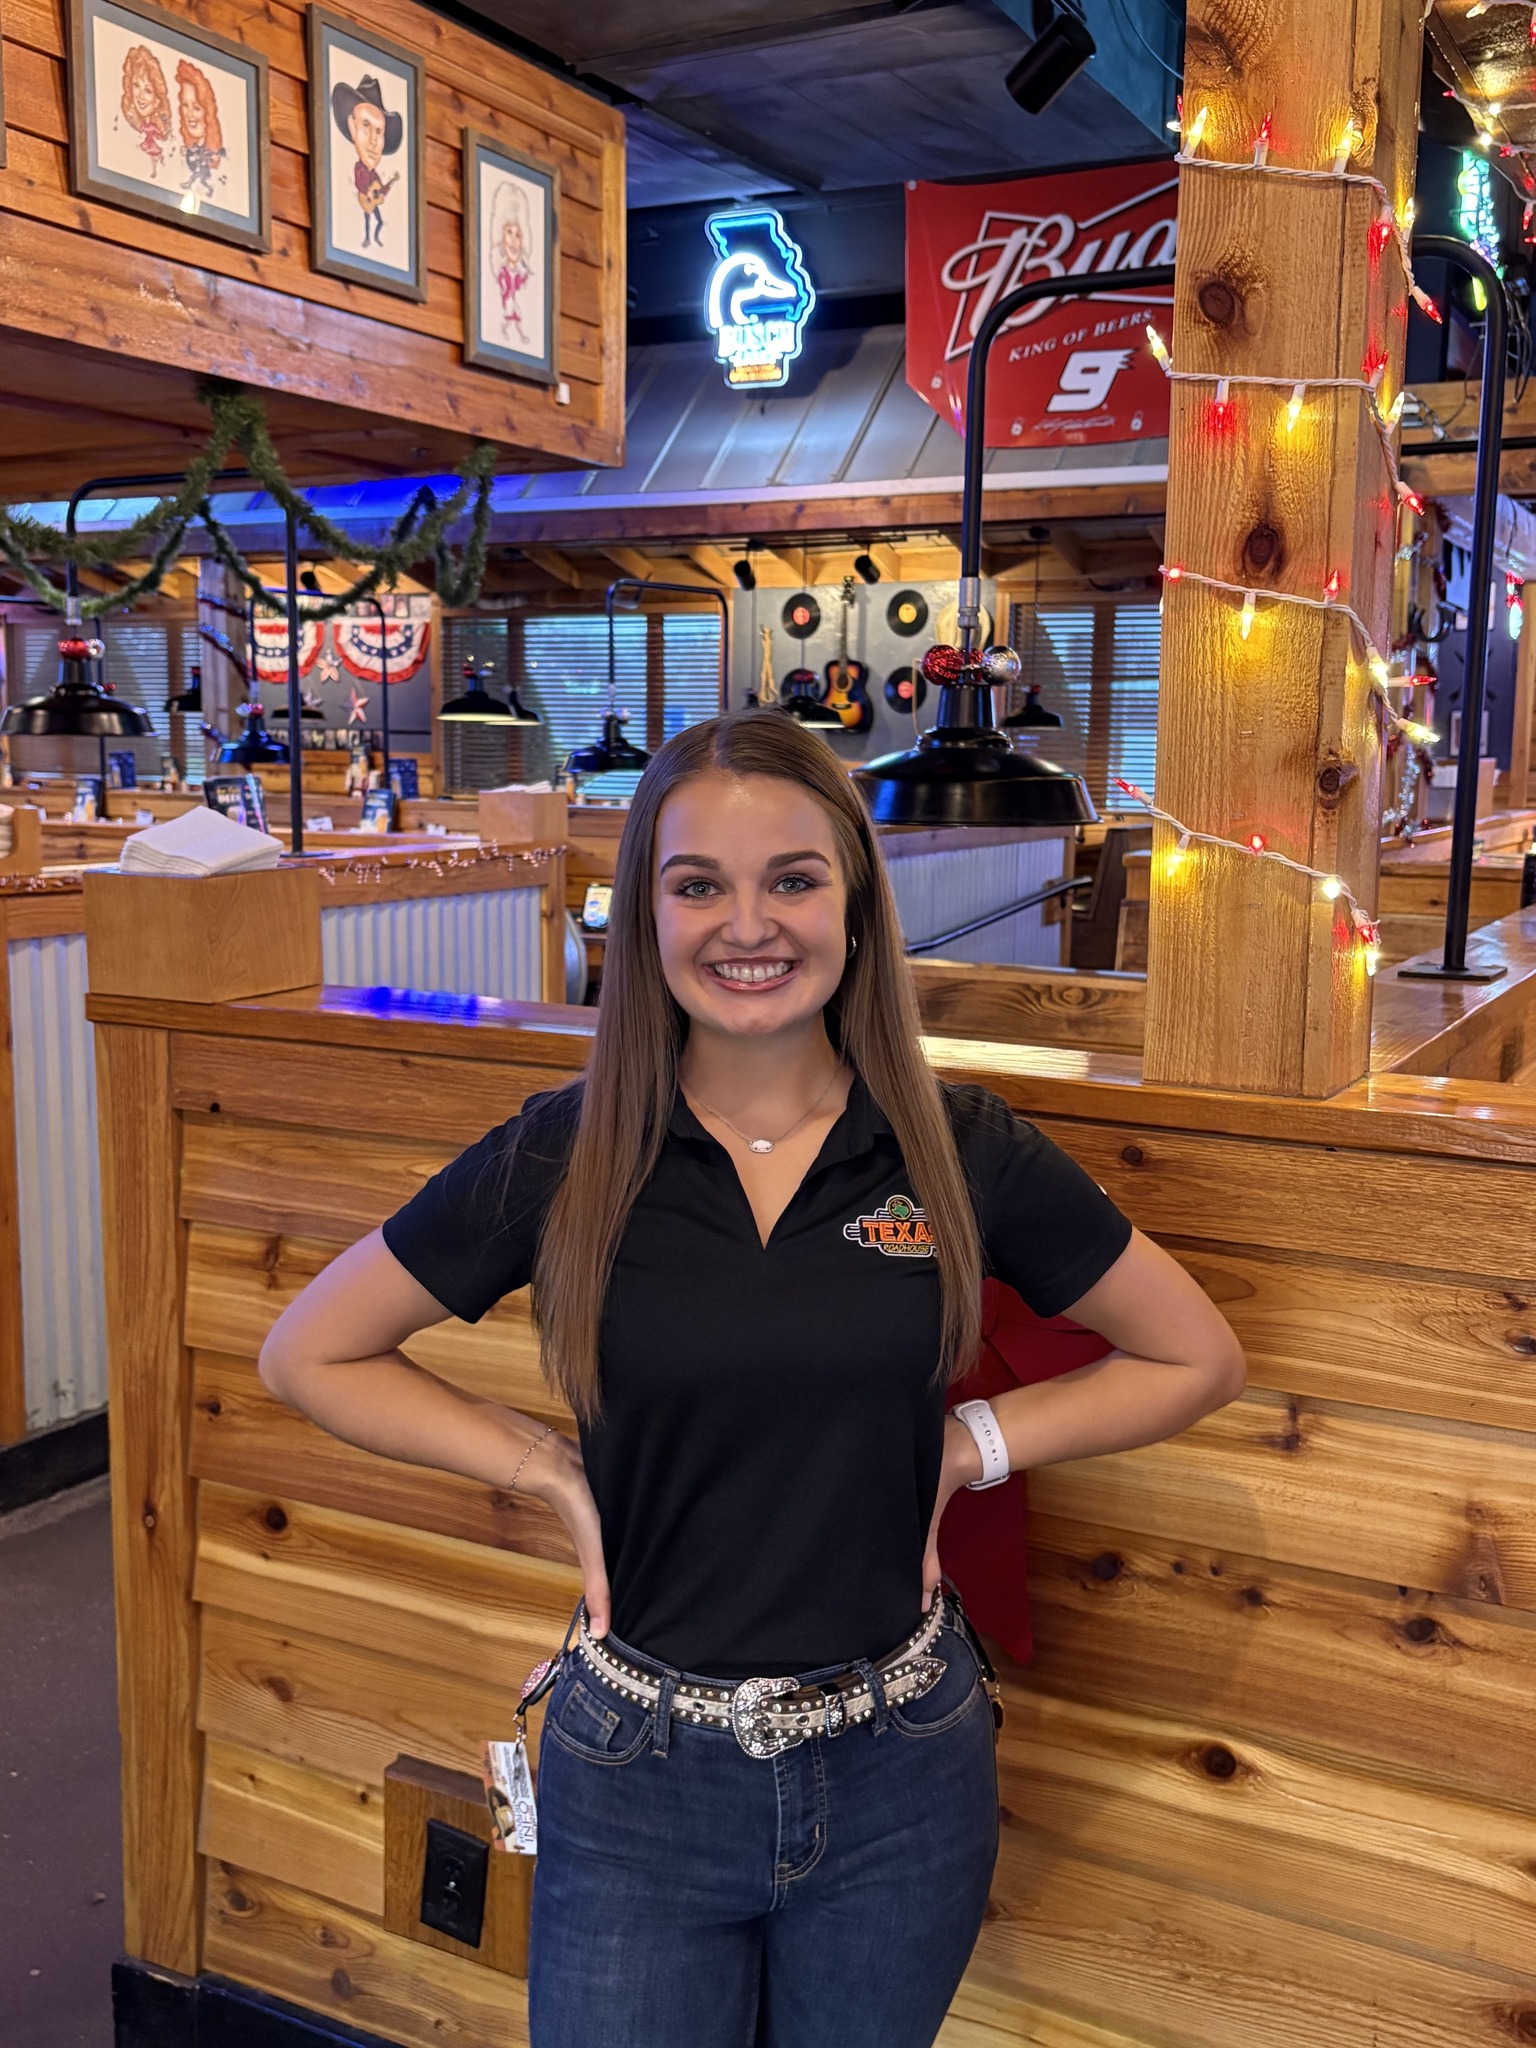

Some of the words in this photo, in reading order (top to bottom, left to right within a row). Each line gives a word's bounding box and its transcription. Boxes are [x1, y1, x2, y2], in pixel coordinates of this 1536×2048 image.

[1008, 336, 1057, 363] KING
[1063, 328, 1088, 347] OF
[1046, 348, 1137, 413] 9
[862, 1221, 934, 1243] TEXA
[883, 1244, 930, 1254] ROADHOUSE
